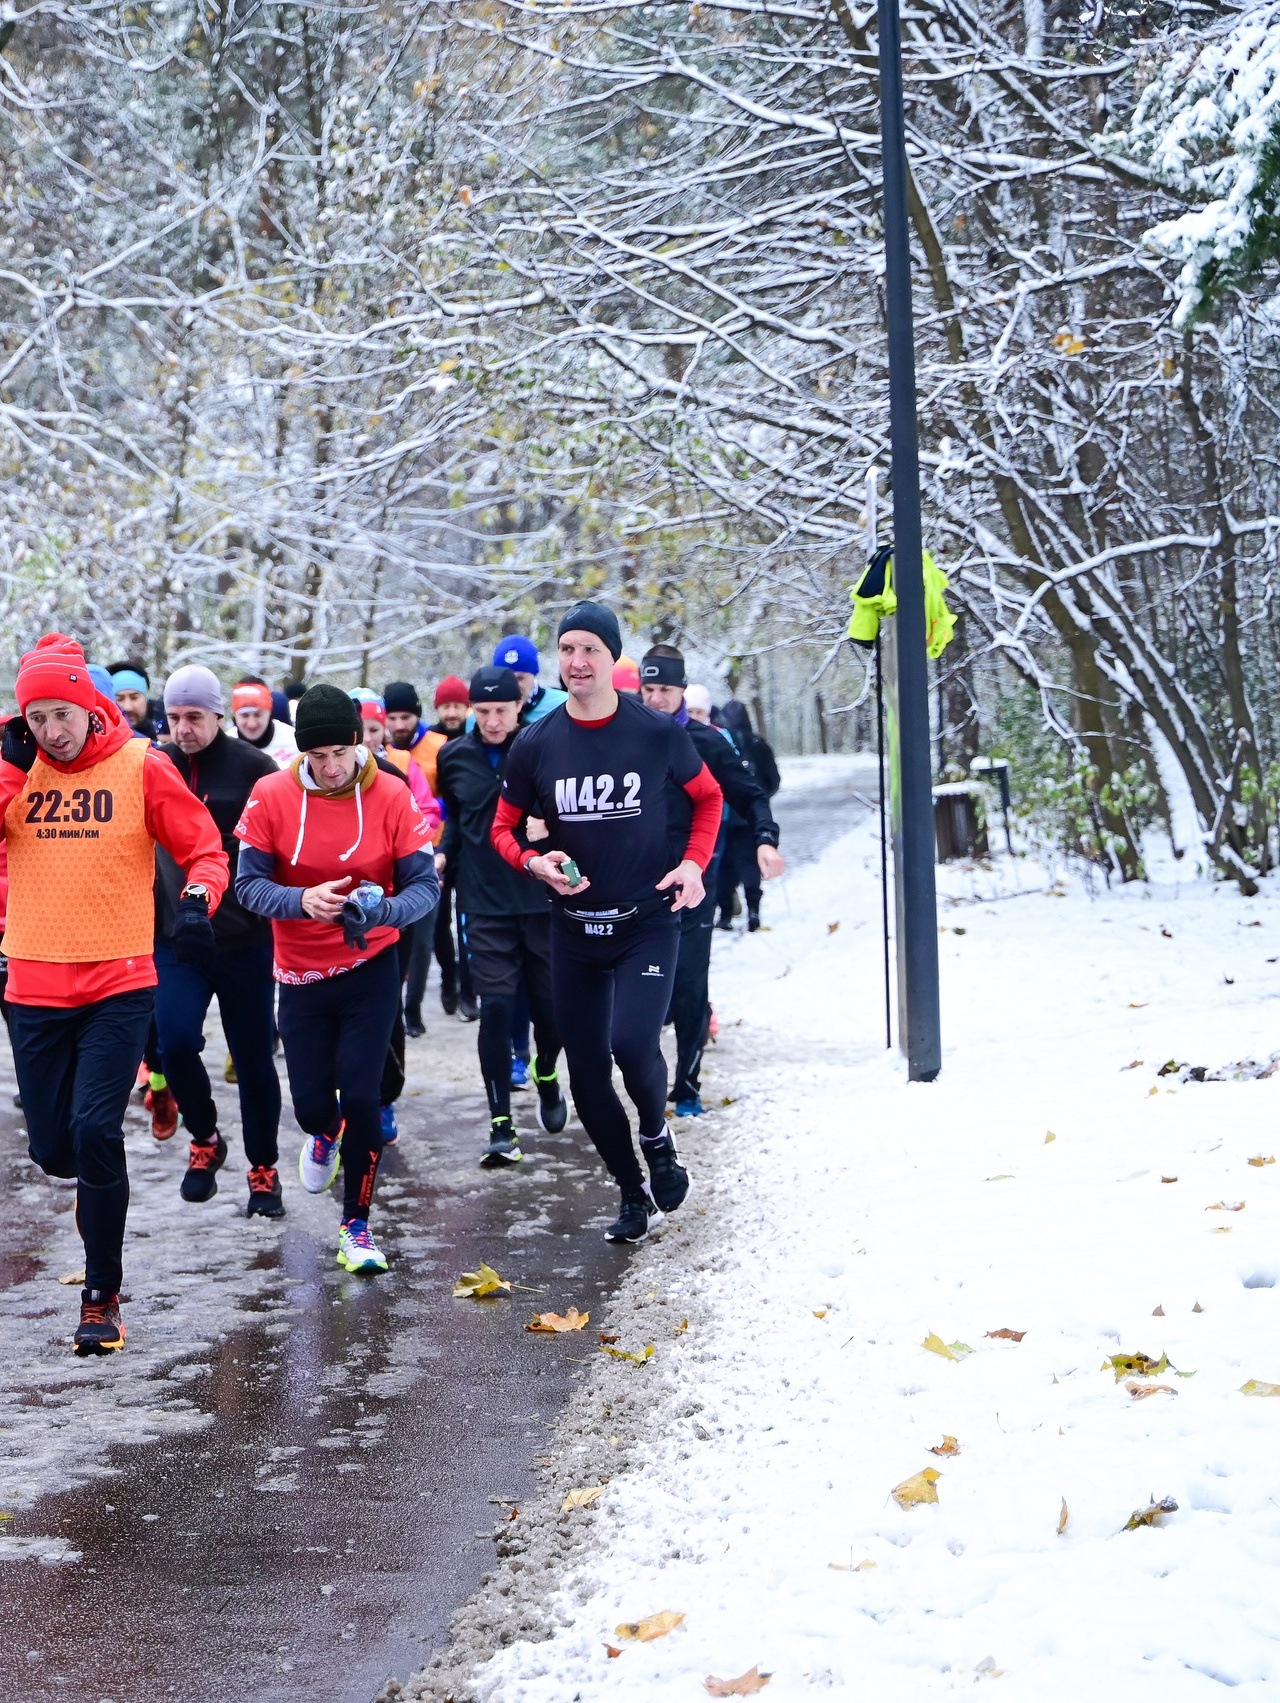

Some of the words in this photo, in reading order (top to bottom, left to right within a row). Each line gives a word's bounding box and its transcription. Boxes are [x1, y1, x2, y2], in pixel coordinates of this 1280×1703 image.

[555, 771, 641, 814] M42.2
[25, 788, 113, 824] 22:30
[36, 828, 57, 839] 4:30
[59, 828, 100, 839] мин/км
[584, 923, 613, 936] M42.2
